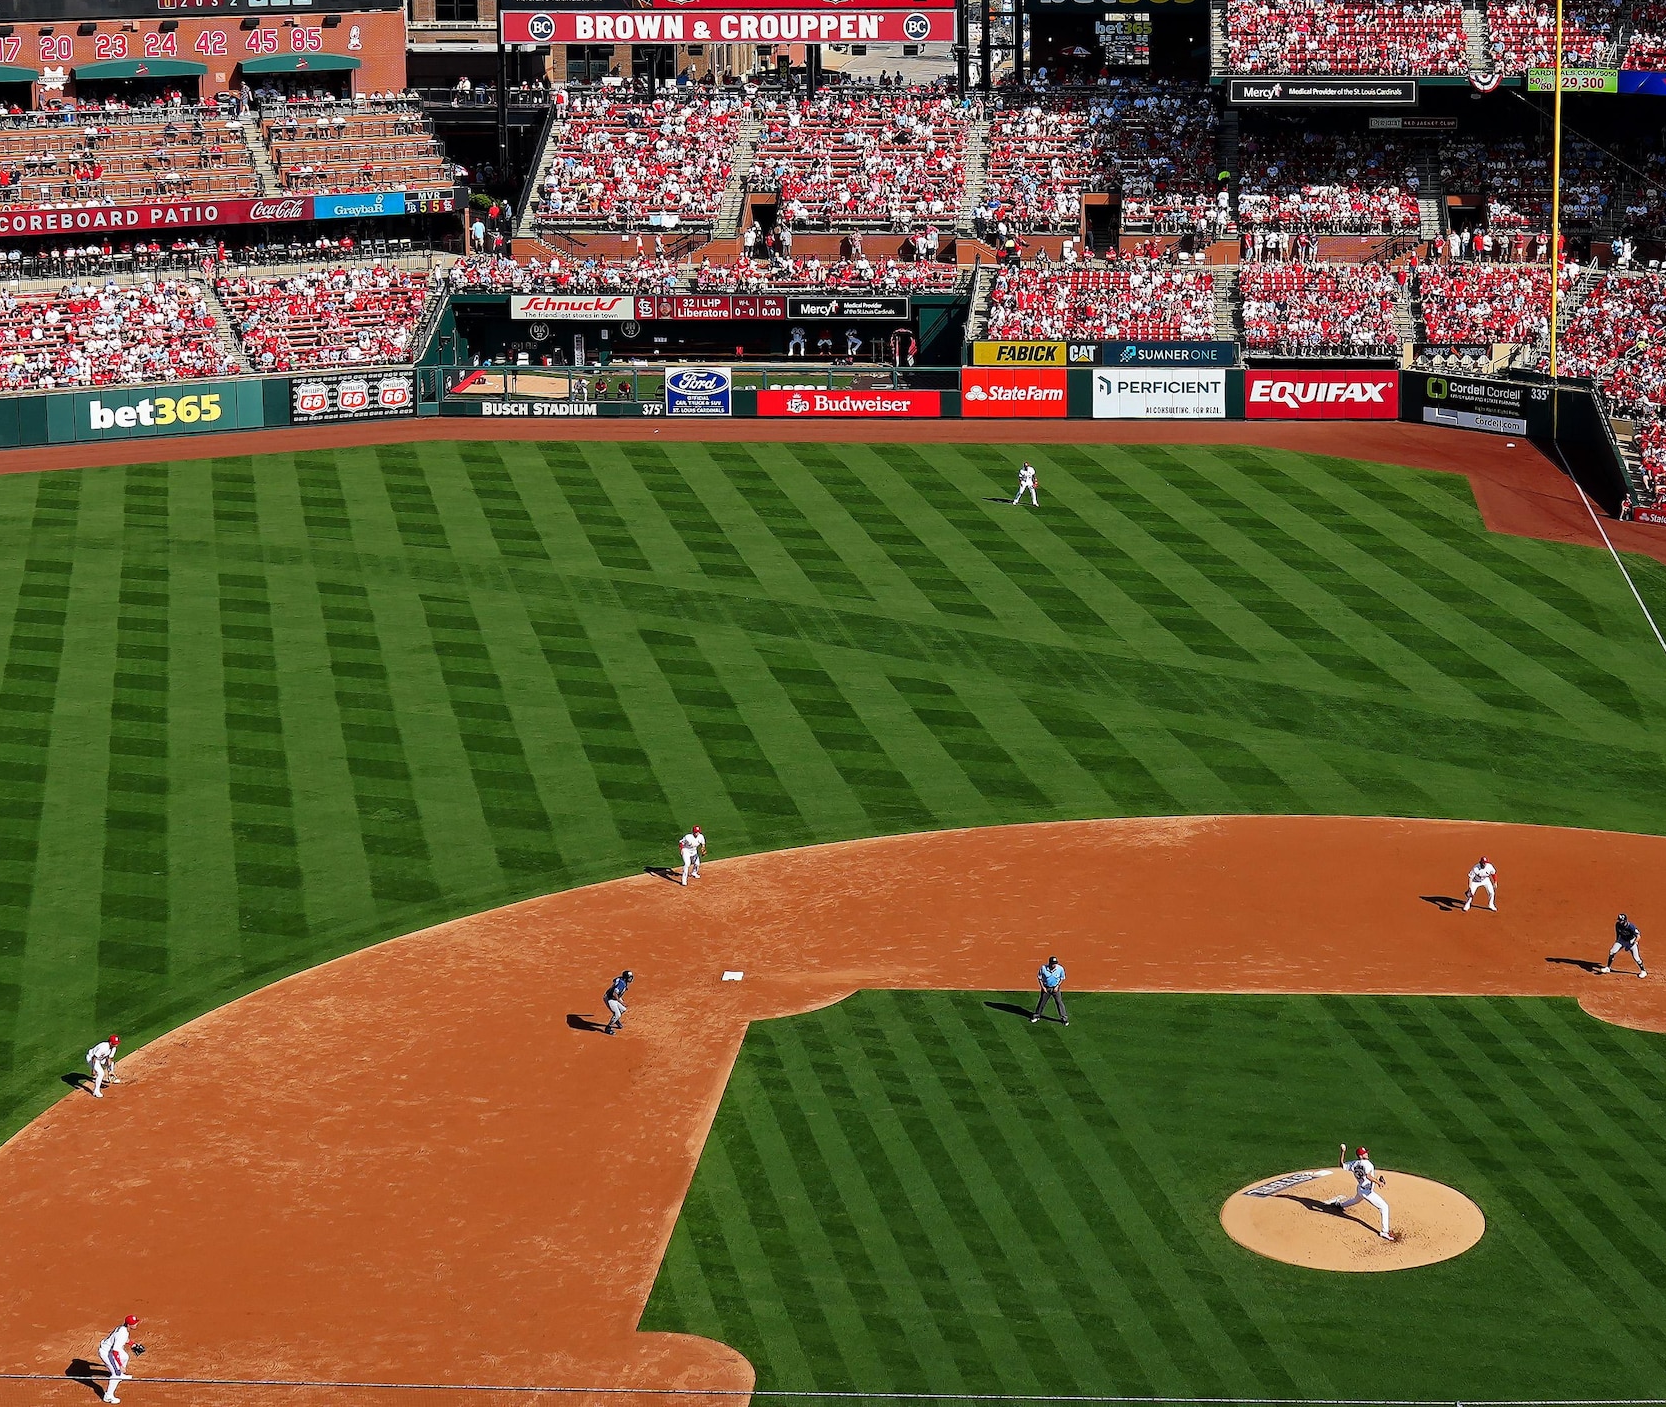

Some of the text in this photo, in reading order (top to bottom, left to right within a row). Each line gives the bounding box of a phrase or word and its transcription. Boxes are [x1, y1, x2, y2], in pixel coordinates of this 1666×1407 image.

[575, 14, 879, 39] BROWN & CROUPPEN
[1095, 21, 1152, 35] bet365
[39, 35, 74, 61] 20
[195, 30, 228, 56] 42
[291, 27, 323, 52] 85
[1562, 77, 1605, 90] 29,300
[1244, 86, 1274, 99] Mercy
[150, 205, 219, 224] PATIO
[249, 199, 303, 220] Coca-Cola
[520, 297, 622, 311] Schnucks
[677, 308, 728, 318] Liberatore
[996, 346, 1058, 361] FABICK
[1069, 345, 1097, 363] CAT
[1138, 349, 1218, 360] SUMNERONE
[678, 373, 717, 390] Ford
[1117, 381, 1221, 393] PERFICIENT
[988, 386, 1064, 401] StateFarm
[1249, 380, 1388, 408] EQUIFAX
[1450, 382, 1485, 396] Cordell
[1487, 386, 1520, 400] Cordell
[89, 393, 222, 430] bet365
[482, 402, 597, 415] BUSCH STADIUM
[814, 395, 911, 412] Budweiser
[1475, 417, 1520, 431] cordell.com
